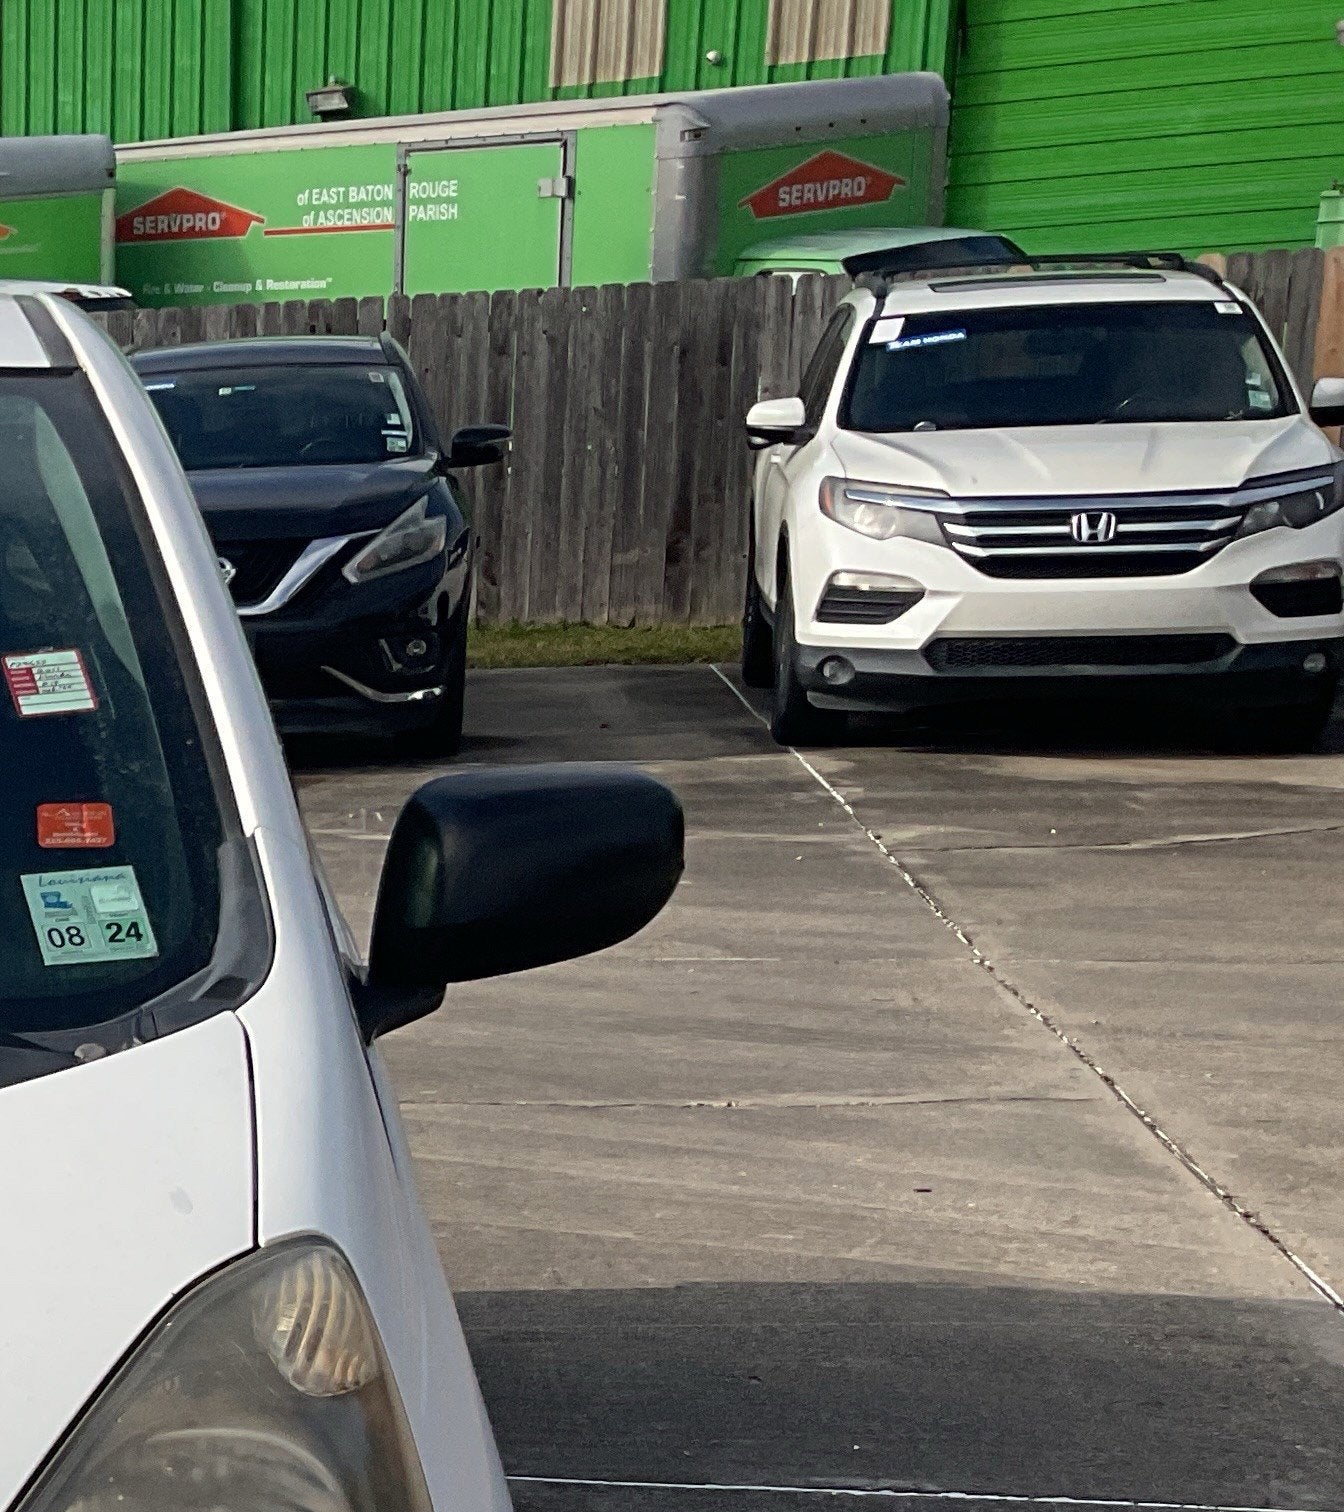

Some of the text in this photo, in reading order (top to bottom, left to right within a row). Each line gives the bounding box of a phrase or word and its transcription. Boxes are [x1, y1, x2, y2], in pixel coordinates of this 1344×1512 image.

[297, 180, 458, 206] of EAST BATON ROUGE
[778, 176, 866, 207] SERVPRO
[132, 211, 221, 235] SERVPRO
[302, 203, 458, 227] of ASCENSION PARISH
[47, 921, 144, 948] 08 24
